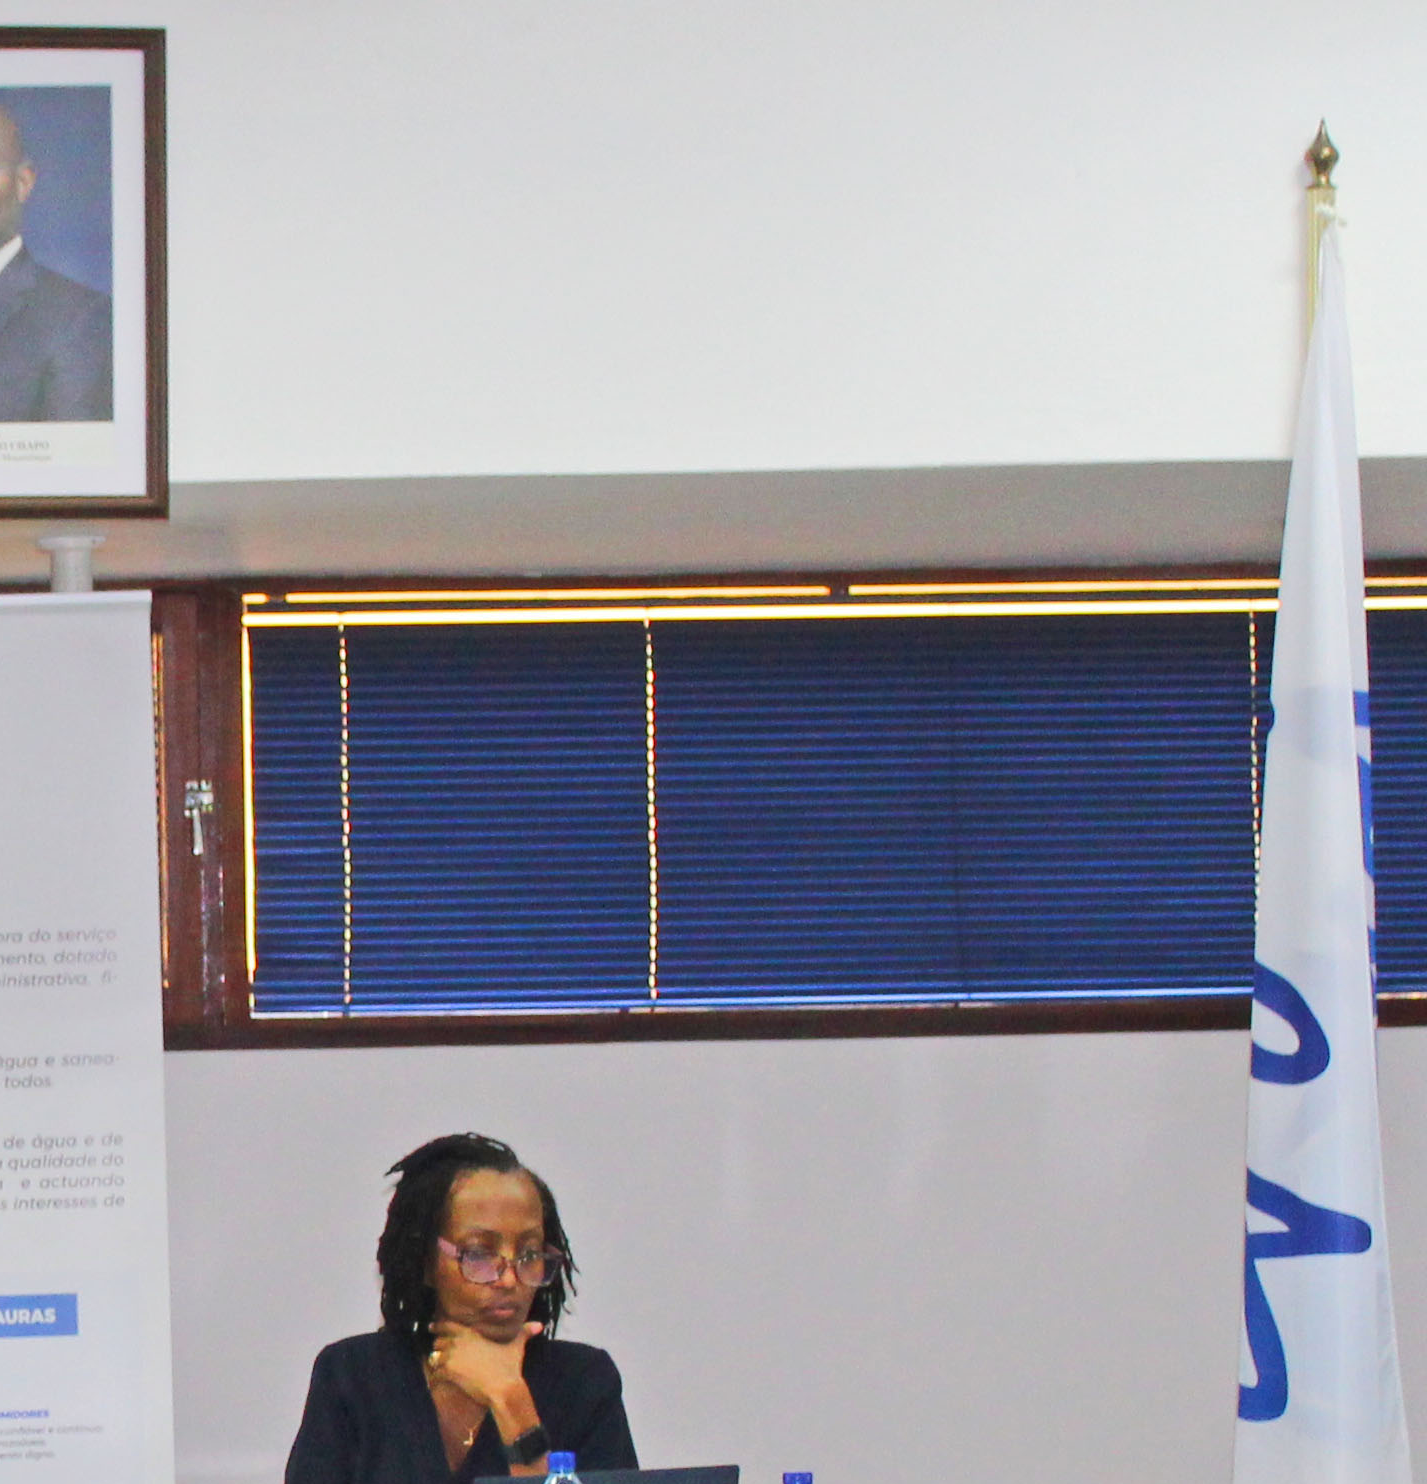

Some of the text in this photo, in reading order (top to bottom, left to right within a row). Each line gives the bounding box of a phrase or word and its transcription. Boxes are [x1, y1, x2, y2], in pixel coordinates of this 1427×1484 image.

[29, 928, 51, 944] do
[56, 927, 118, 946] serviço
[45, 1055, 56, 1067] e
[3, 1135, 26, 1150] de
[32, 1133, 76, 1152] água
[84, 1135, 95, 1148] e
[101, 1131, 124, 1147] de
[8, 1152, 97, 1172] qualidade
[102, 1152, 124, 1168] do
[21, 1178, 31, 1191] e
[39, 1173, 126, 1191] actuando
[13, 1193, 98, 1211] interesses
[103, 1193, 126, 1209] de
